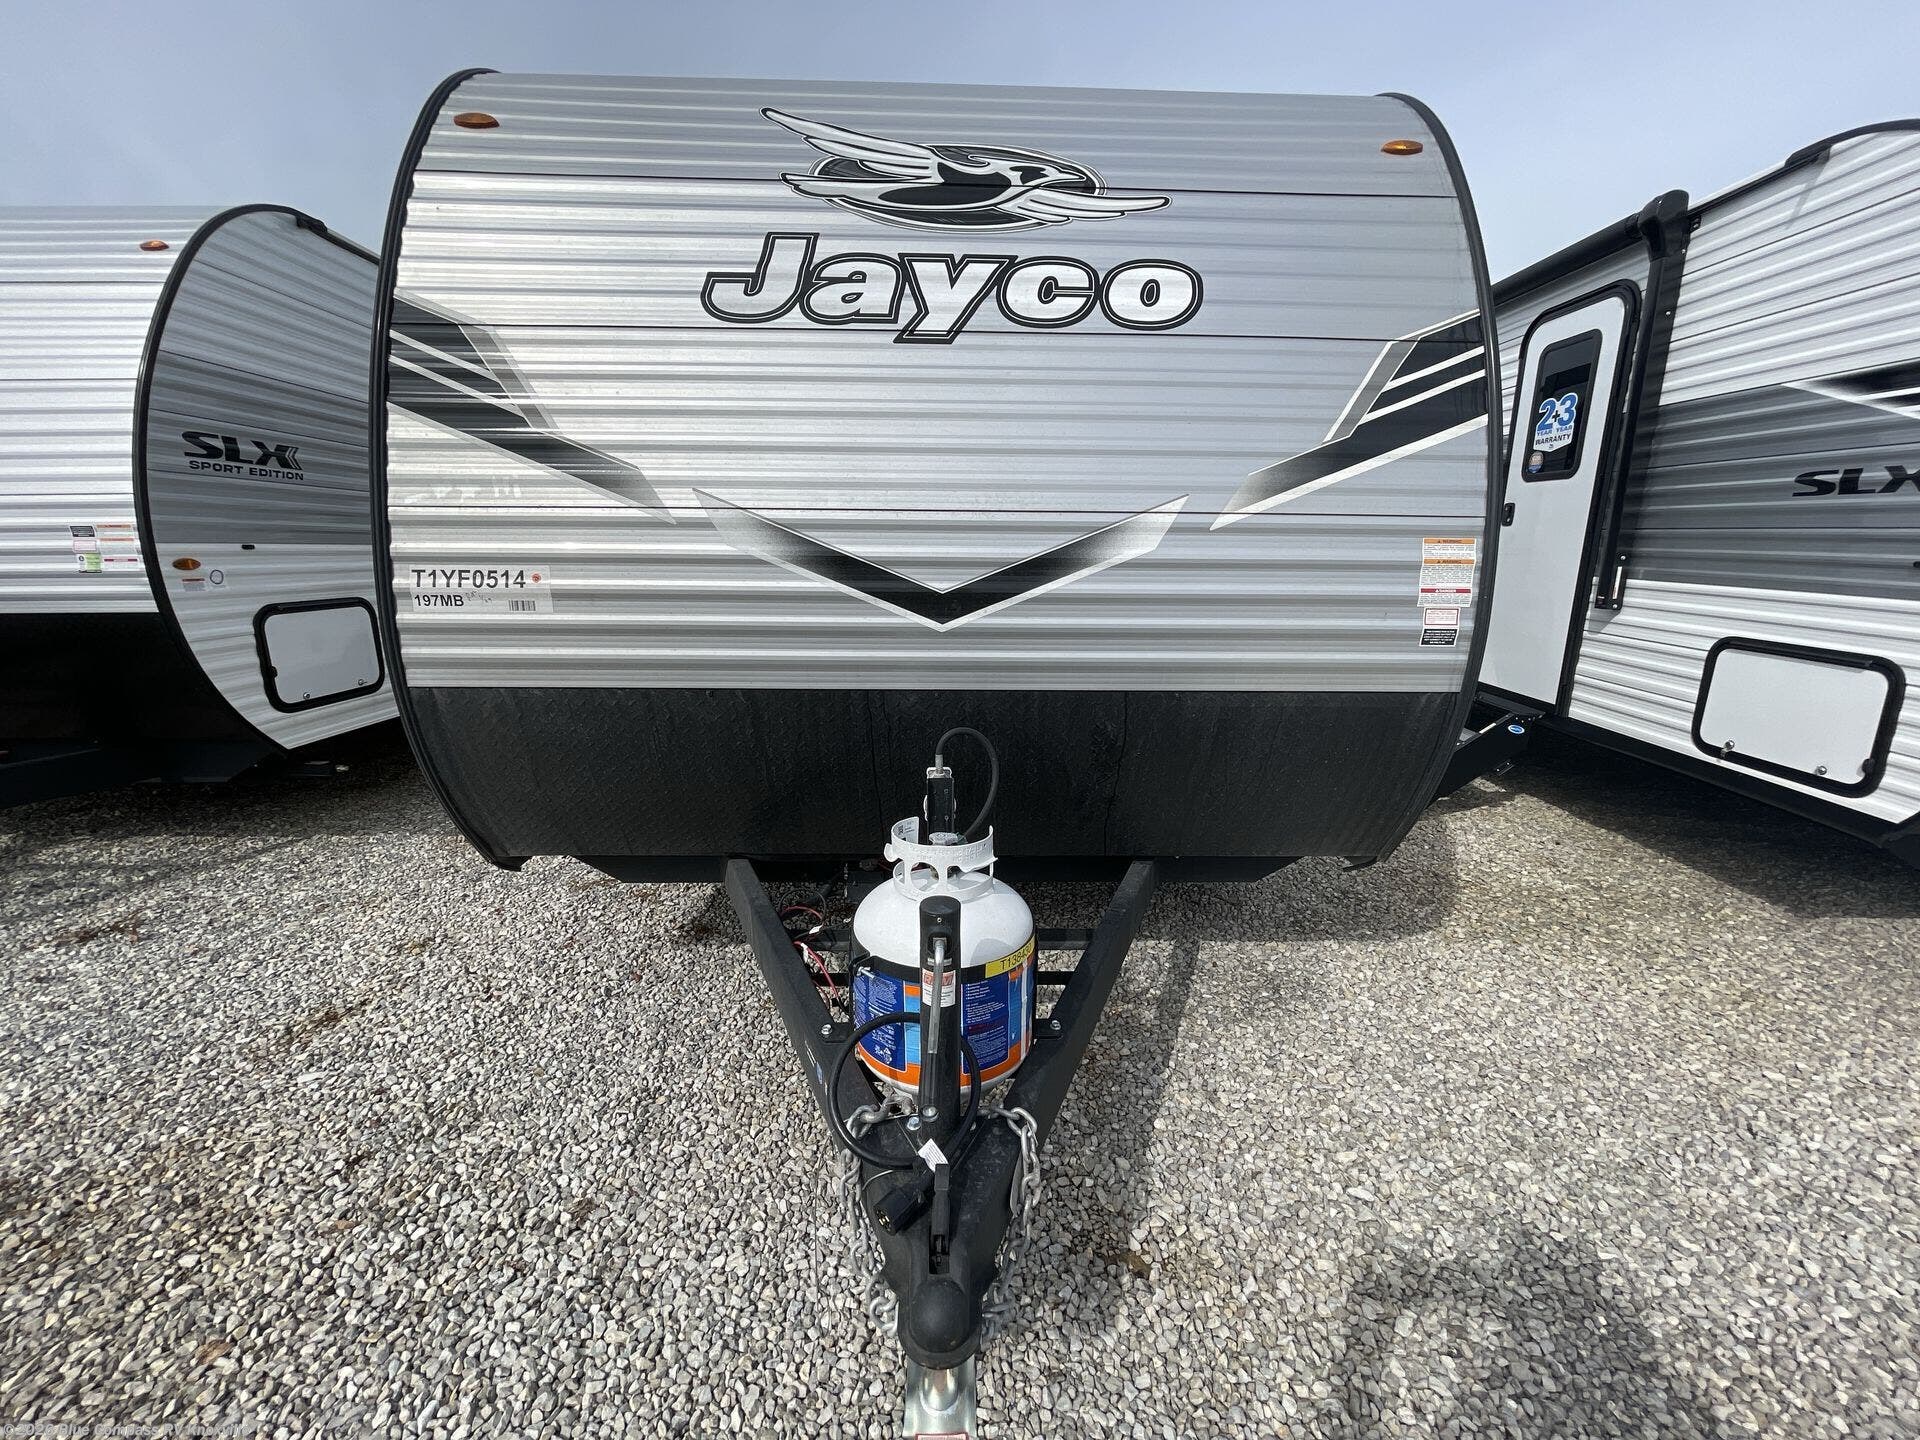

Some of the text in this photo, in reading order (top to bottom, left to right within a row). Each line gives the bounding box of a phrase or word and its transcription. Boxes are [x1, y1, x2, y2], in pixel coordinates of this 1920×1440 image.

[700, 232, 1203, 344] Jayco
[182, 431, 303, 470] SLX
[189, 460, 304, 480] SPORT EDITION
[1792, 465, 1920, 497] SLX
[411, 569, 526, 588] T1YF0514
[414, 594, 464, 607] 197MB
